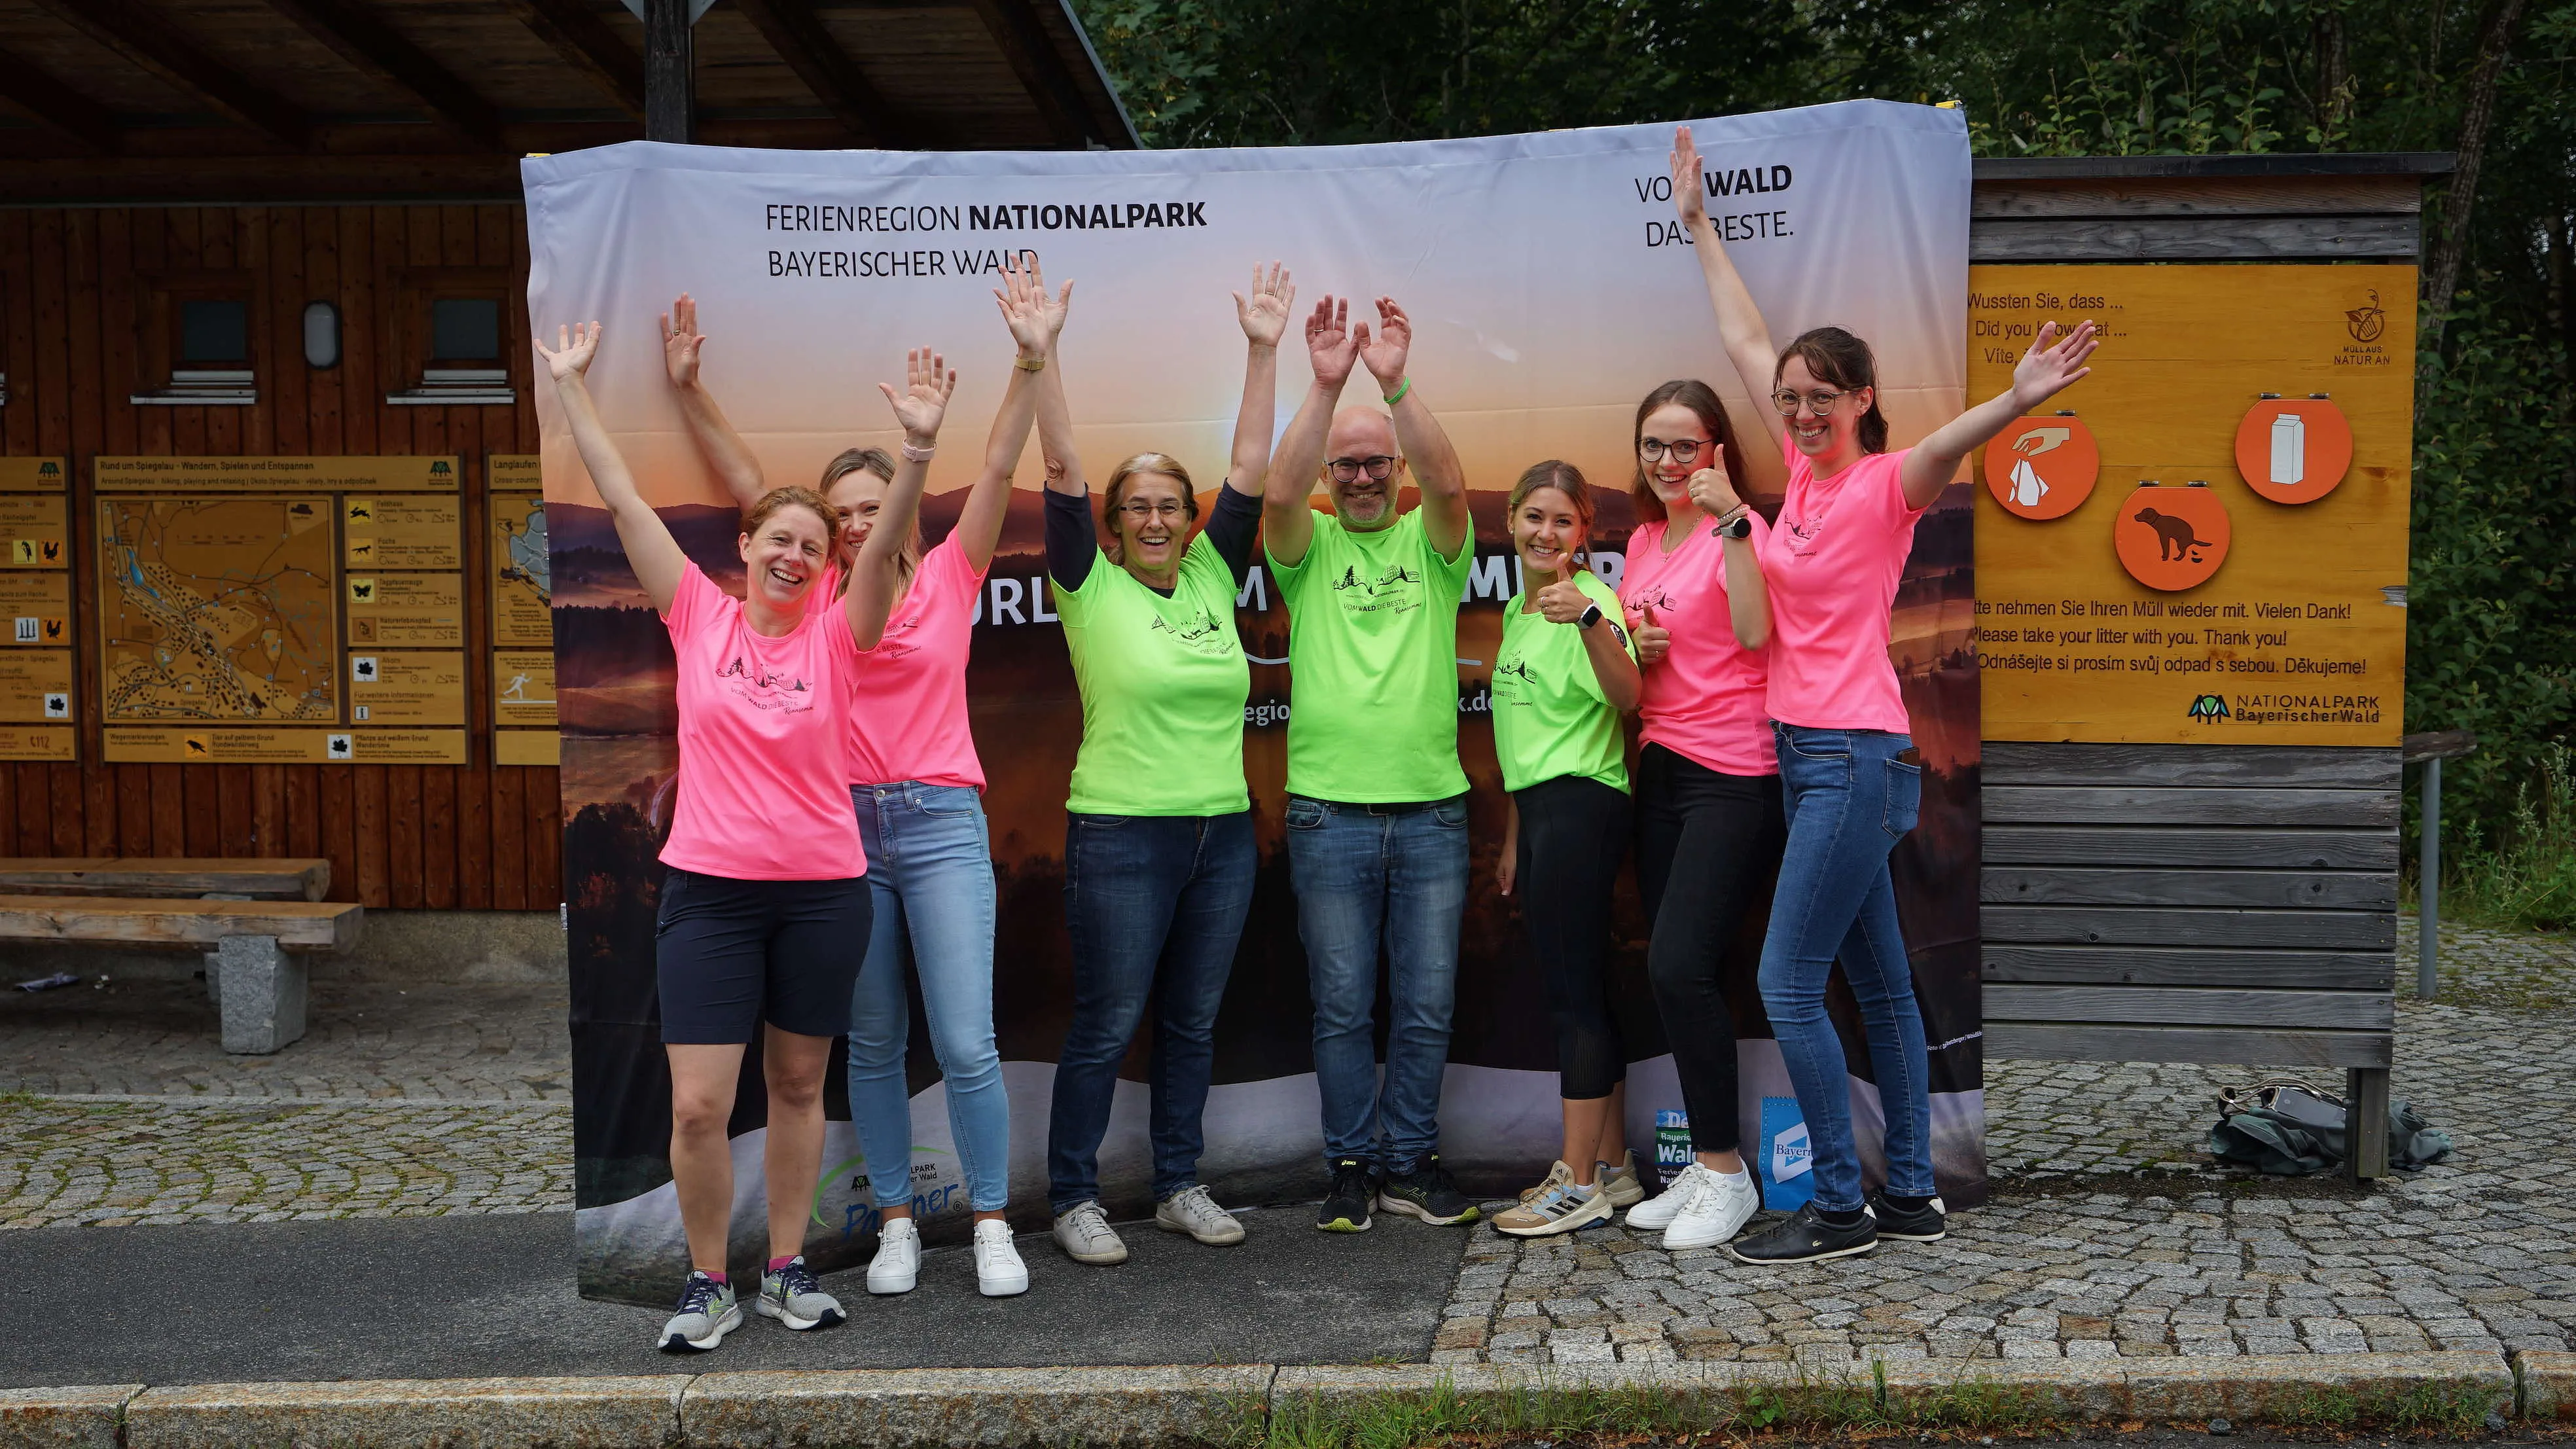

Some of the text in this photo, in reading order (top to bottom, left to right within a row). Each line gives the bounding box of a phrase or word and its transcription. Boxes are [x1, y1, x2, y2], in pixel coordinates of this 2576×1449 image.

[1634, 164, 1792, 202] VO WALD
[766, 202, 1208, 232] FERIENREGION NATIONALPARK
[768, 249, 1039, 277] BAYERISCHER WALD
[1967, 293, 2030, 309] Wussten
[2035, 293, 2064, 311] Sie,
[2069, 293, 2105, 309] dass
[1975, 320, 1999, 336] Did
[2004, 323, 2031, 340] you
[2037, 321, 2077, 336] kow
[1984, 348, 2018, 366] Víte,
[2334, 355, 2390, 365] NATUR AN
[100, 461, 120, 470] Rund
[136, 461, 174, 472] Spiegelau
[221, 461, 249, 472] Spielen
[251, 461, 266, 470] und
[268, 461, 314, 472] Entspannen
[493, 460, 537, 471] Langlaufen
[1973, 599, 2352, 619] tte nehmen Sie Ihren Müll wieder mit. Vielen Dank!
[2022, 627, 2054, 643] take
[2058, 630, 2092, 647] your
[2096, 628, 2129, 644] litter
[2132, 628, 2162, 644] with
[2166, 632, 2198, 648] you.
[2204, 629, 2250, 645] Thank
[2255, 630, 2287, 649] you!
[1978, 653, 2367, 678] Odnášejte si prosím svůj odpad s sebou. Děkujeme!
[2236, 694, 2379, 709] NATIONALPARK
[919, 1171, 937, 1181] Wald
[840, 1183, 959, 1242] Paner
